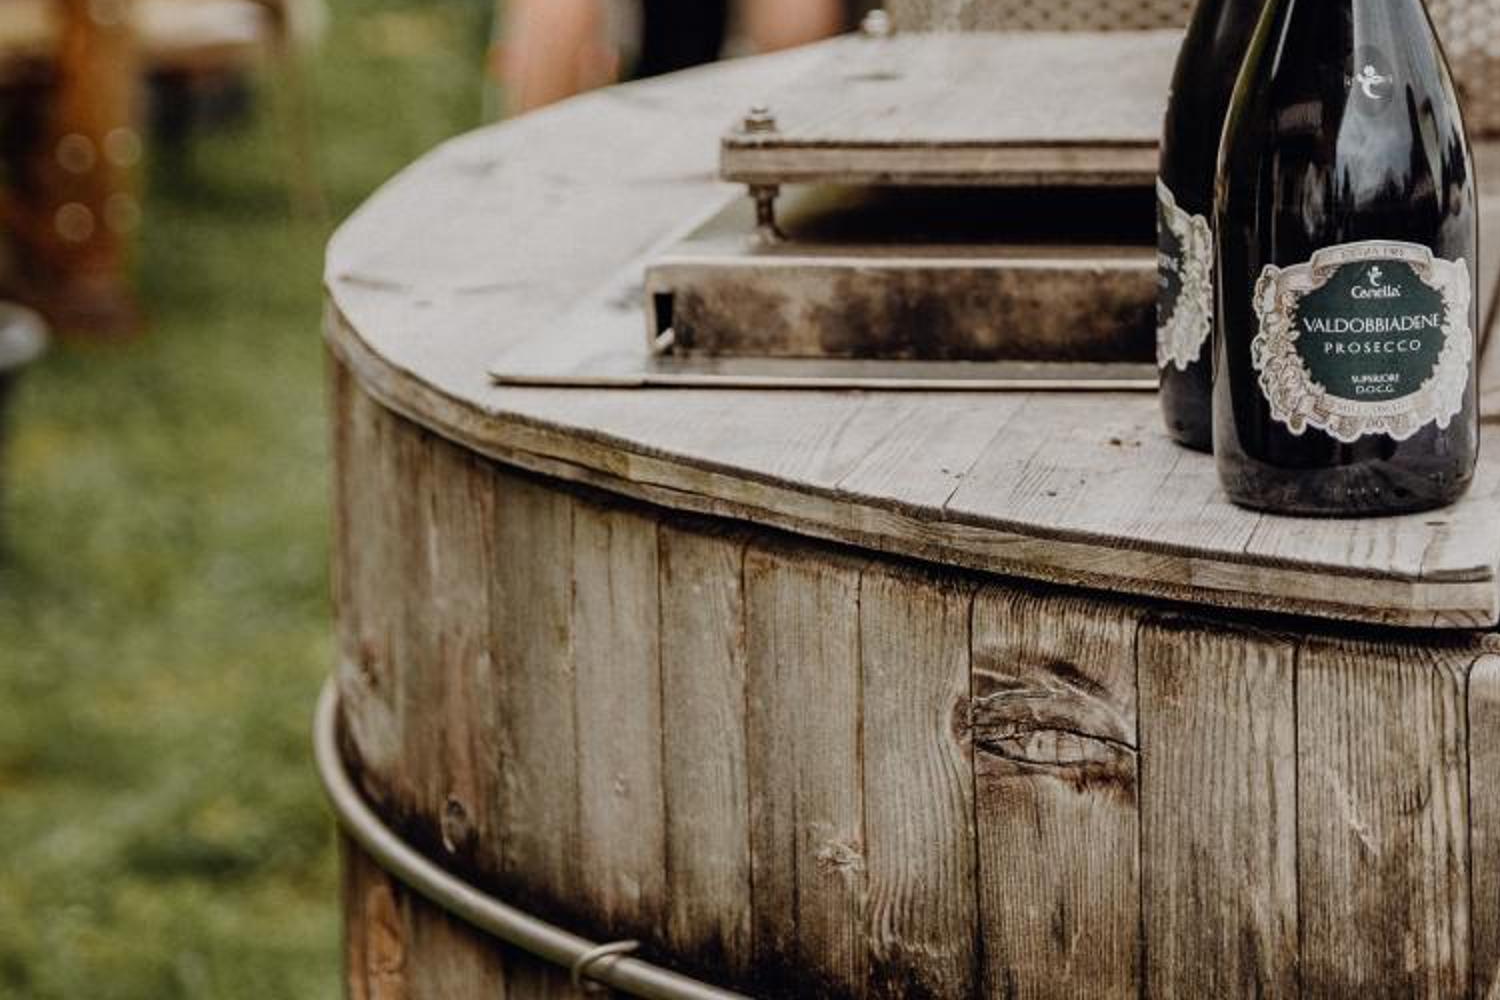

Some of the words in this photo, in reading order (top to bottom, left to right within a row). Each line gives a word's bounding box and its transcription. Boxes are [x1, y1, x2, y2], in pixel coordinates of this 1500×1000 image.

[1350, 285, 1401, 299] Canella
[1303, 313, 1440, 333] VALDOBBIADENE
[1324, 339, 1421, 354] PROSECCO
